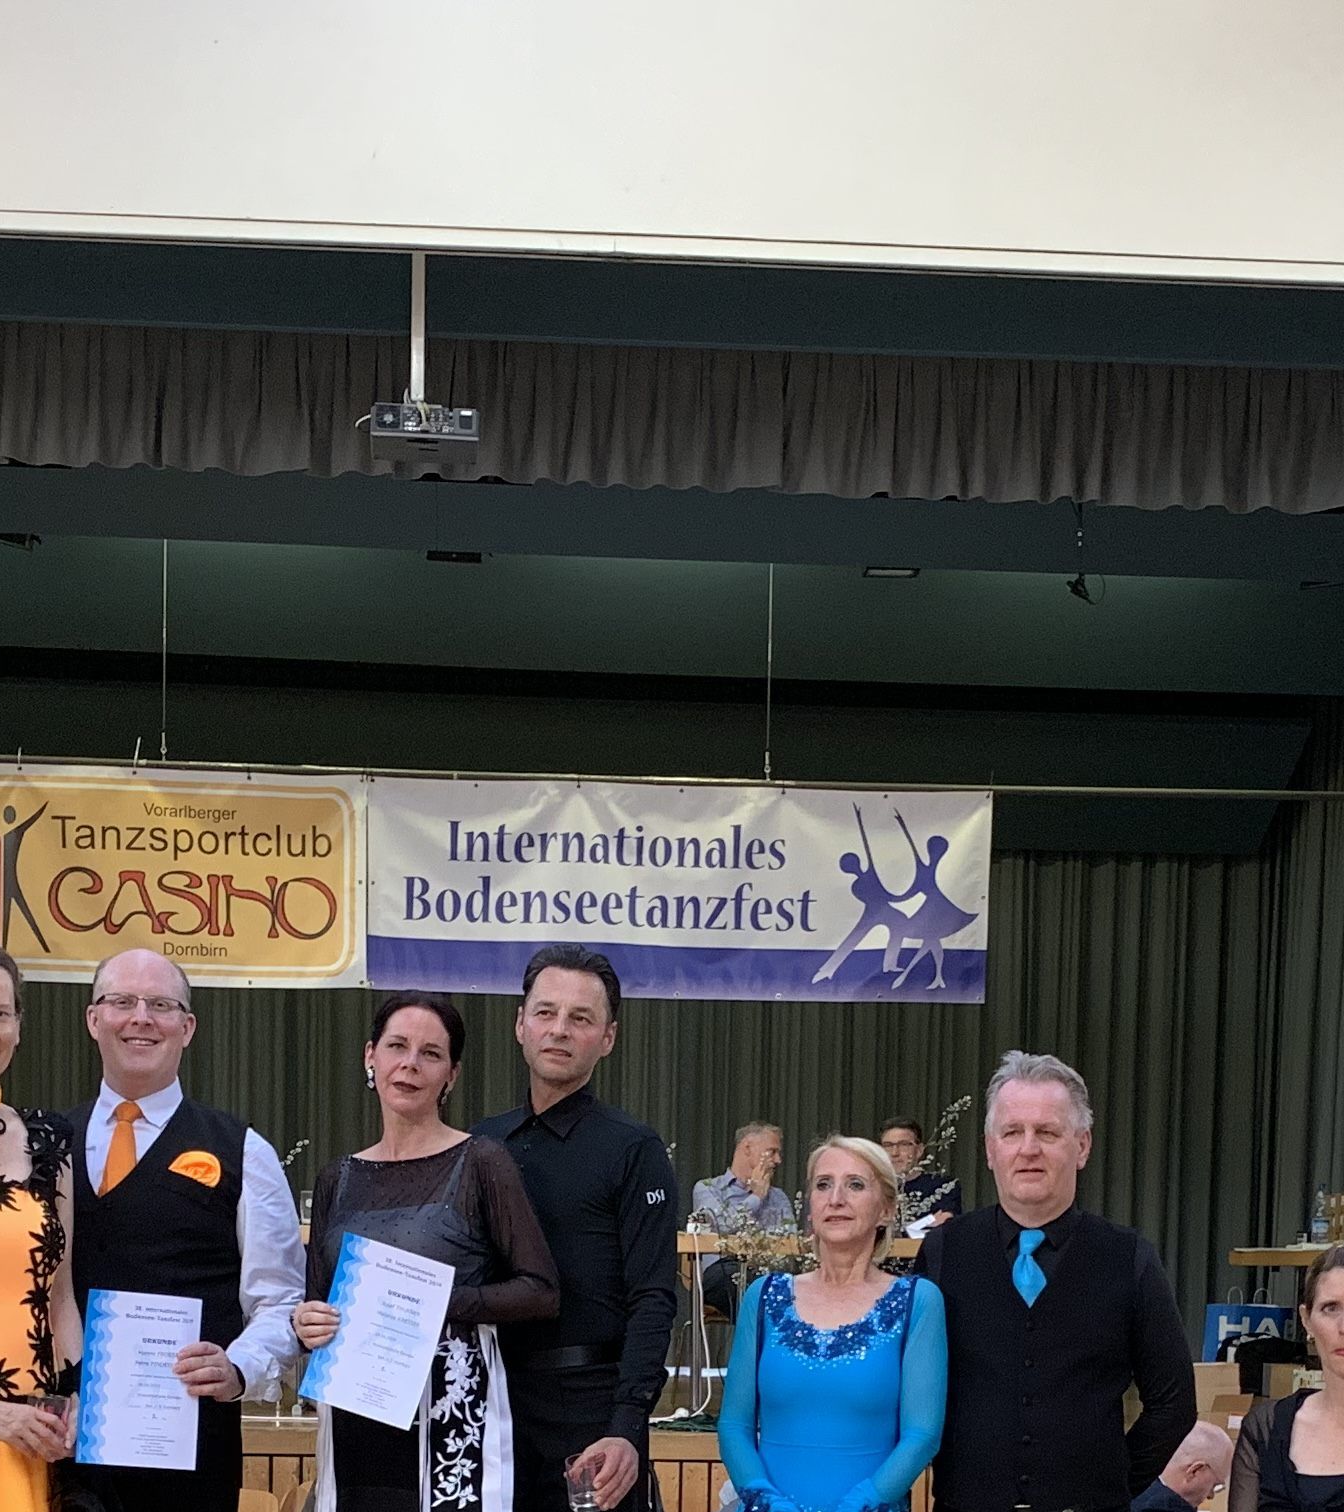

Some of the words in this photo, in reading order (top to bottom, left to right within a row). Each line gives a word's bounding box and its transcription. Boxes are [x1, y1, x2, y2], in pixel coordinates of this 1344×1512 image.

[143, 801, 237, 823] Vorarlberger
[50, 814, 334, 861] Tanzsportclub
[447, 819, 787, 871] Internationales
[47, 865, 338, 940] CASINO
[402, 875, 818, 933] Bodenseetanzfest
[163, 941, 228, 959] Dornbirn
[646, 1189, 666, 1205] DSI
